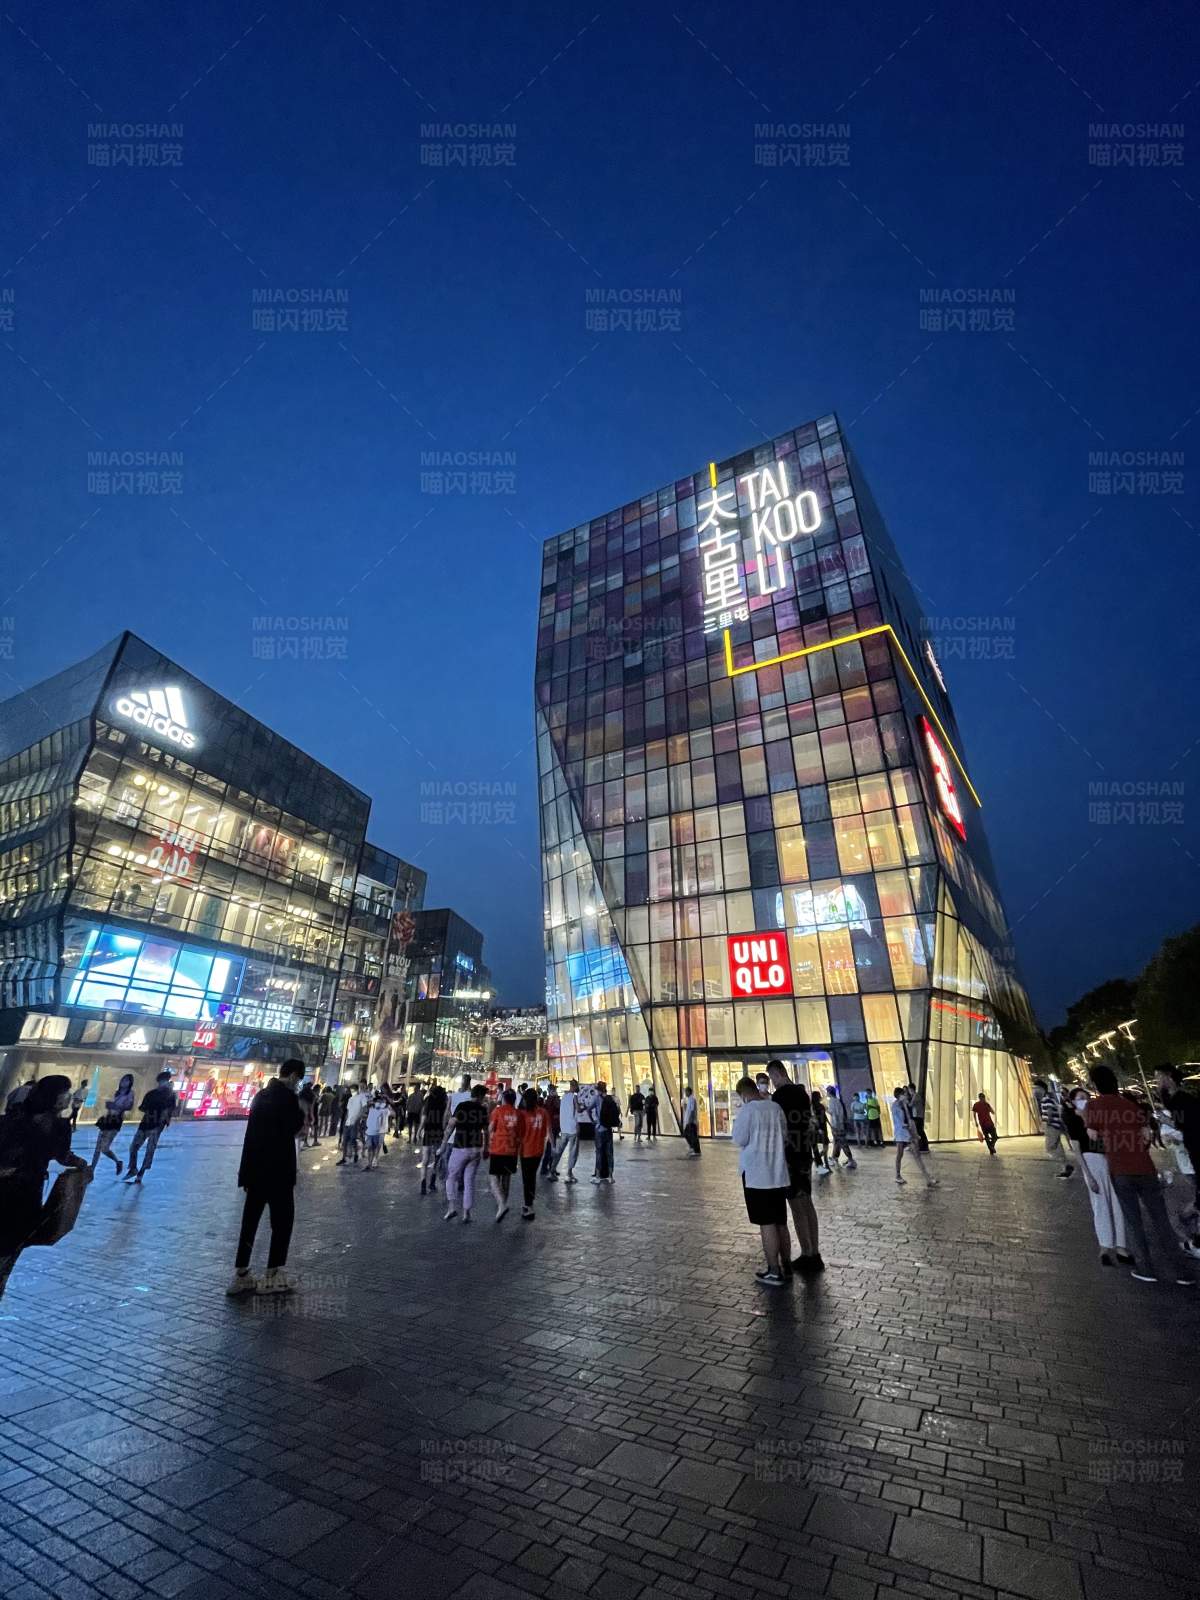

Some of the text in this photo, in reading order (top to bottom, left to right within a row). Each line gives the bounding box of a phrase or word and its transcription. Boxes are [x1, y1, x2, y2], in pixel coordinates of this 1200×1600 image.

[740, 460, 789, 511] TAI
[752, 490, 822, 552] KOO
[697, 489, 747, 614] 太古里
[757, 546, 787, 595] LI
[116, 698, 196, 749] adidas
[733, 938, 778, 964] UNI
[735, 965, 785, 993] QLO
